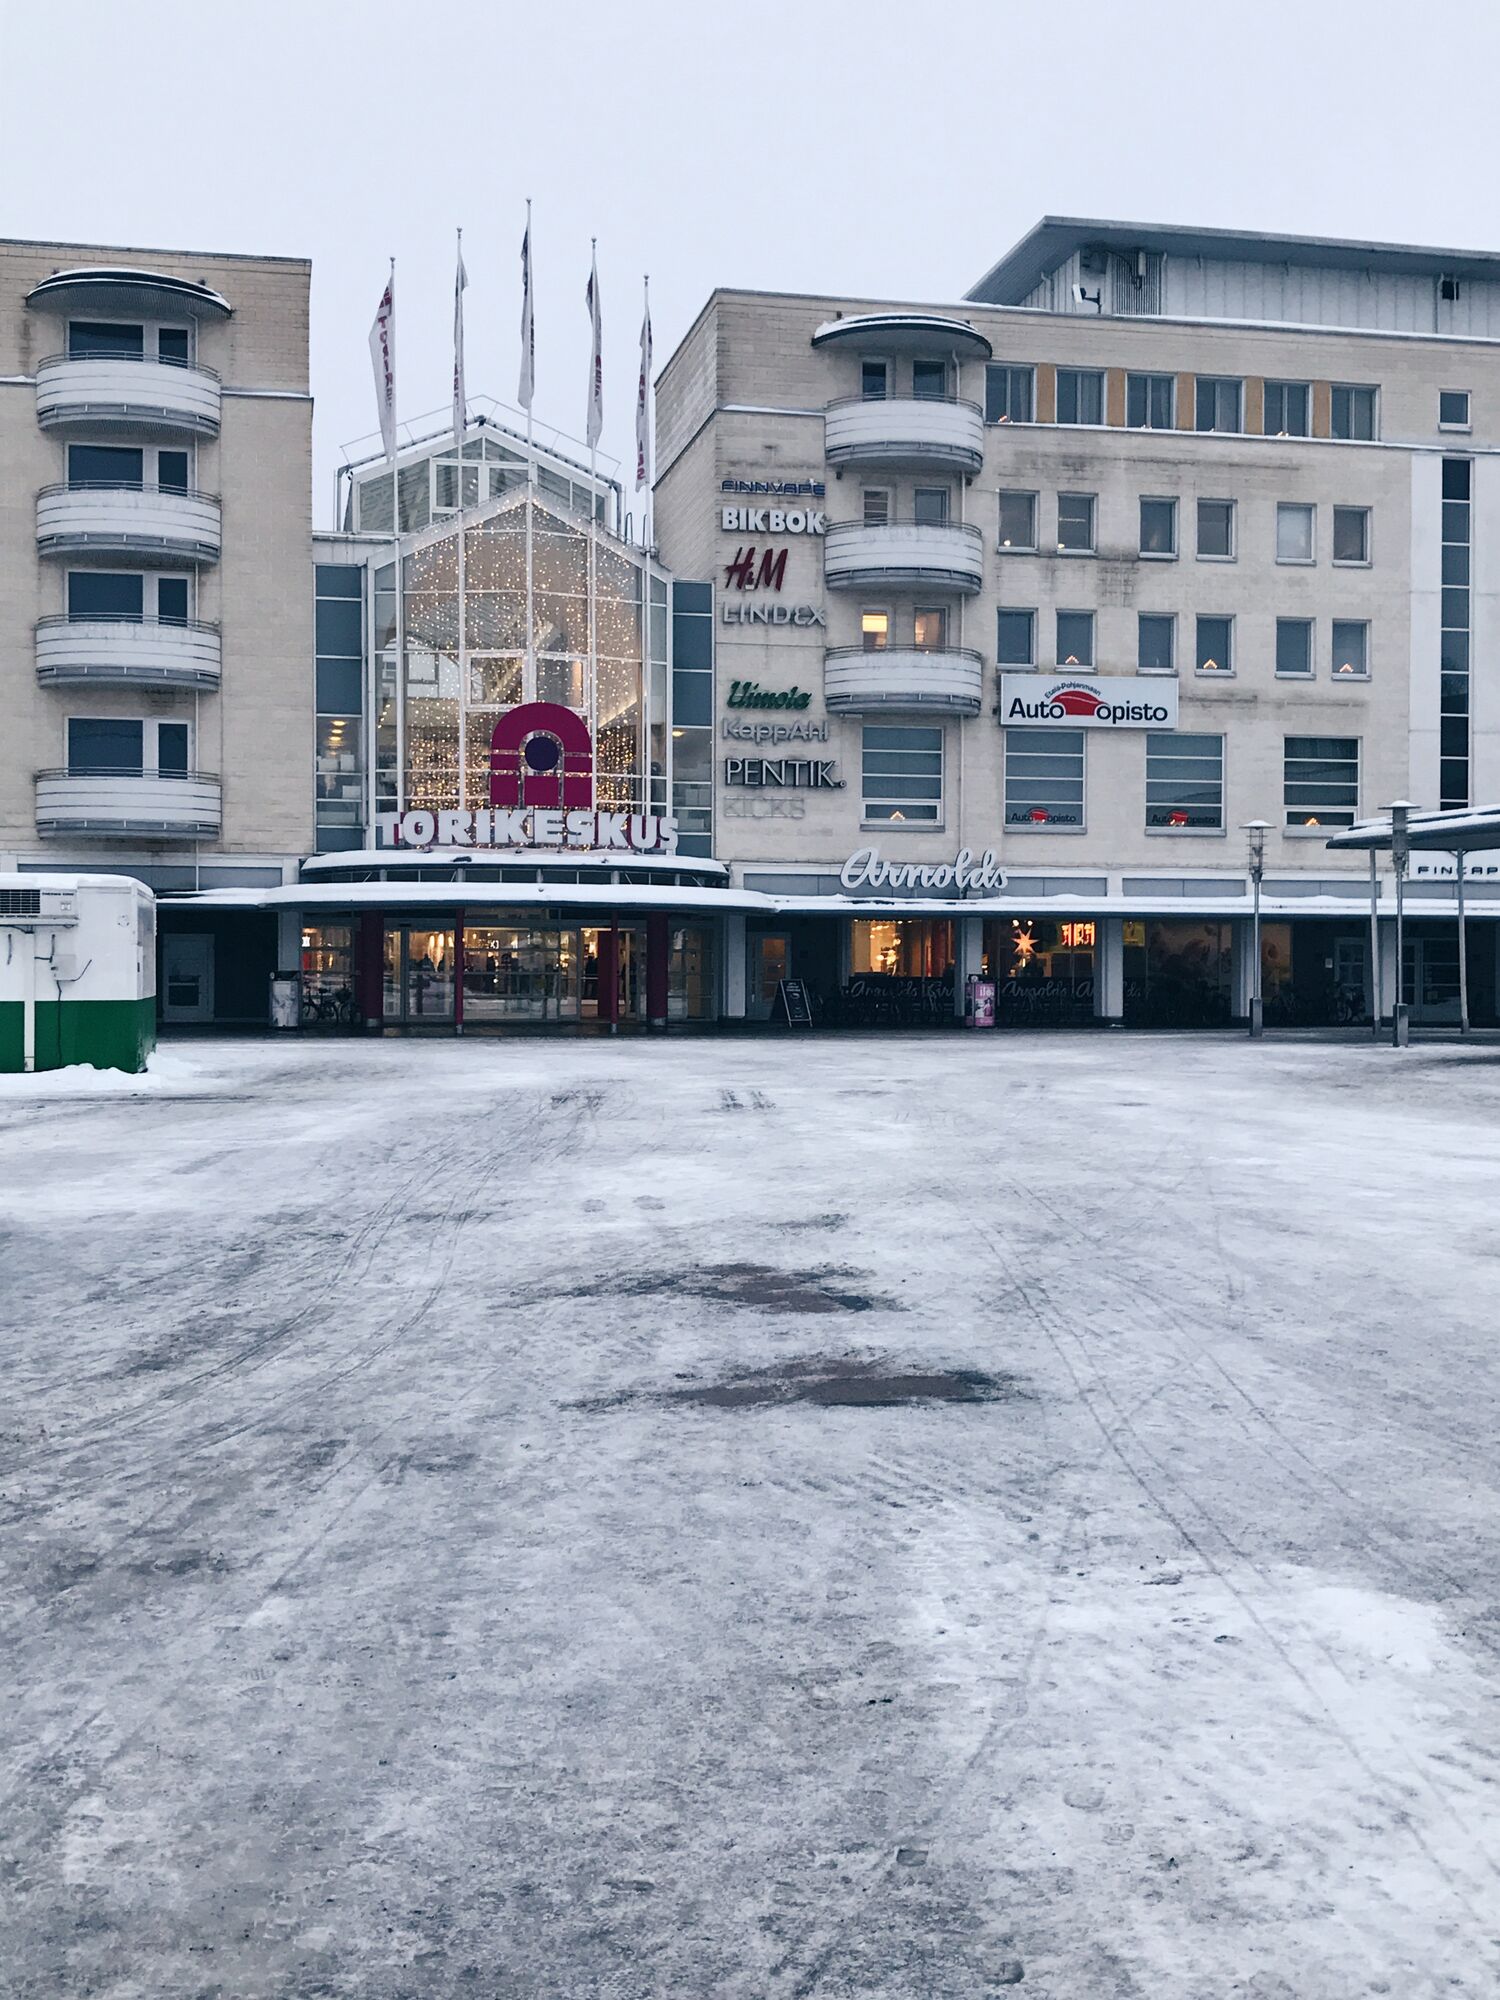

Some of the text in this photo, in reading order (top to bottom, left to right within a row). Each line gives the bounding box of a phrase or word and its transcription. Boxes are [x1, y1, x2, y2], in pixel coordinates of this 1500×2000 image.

[725, 547, 788, 592] H&M
[723, 604, 826, 627] LINDEX
[1009, 697, 1168, 724] Auto opisto
[723, 718, 829, 745] KappAhl
[375, 809, 678, 850] TORIKESKUS
[840, 847, 1008, 889] Arnolds
